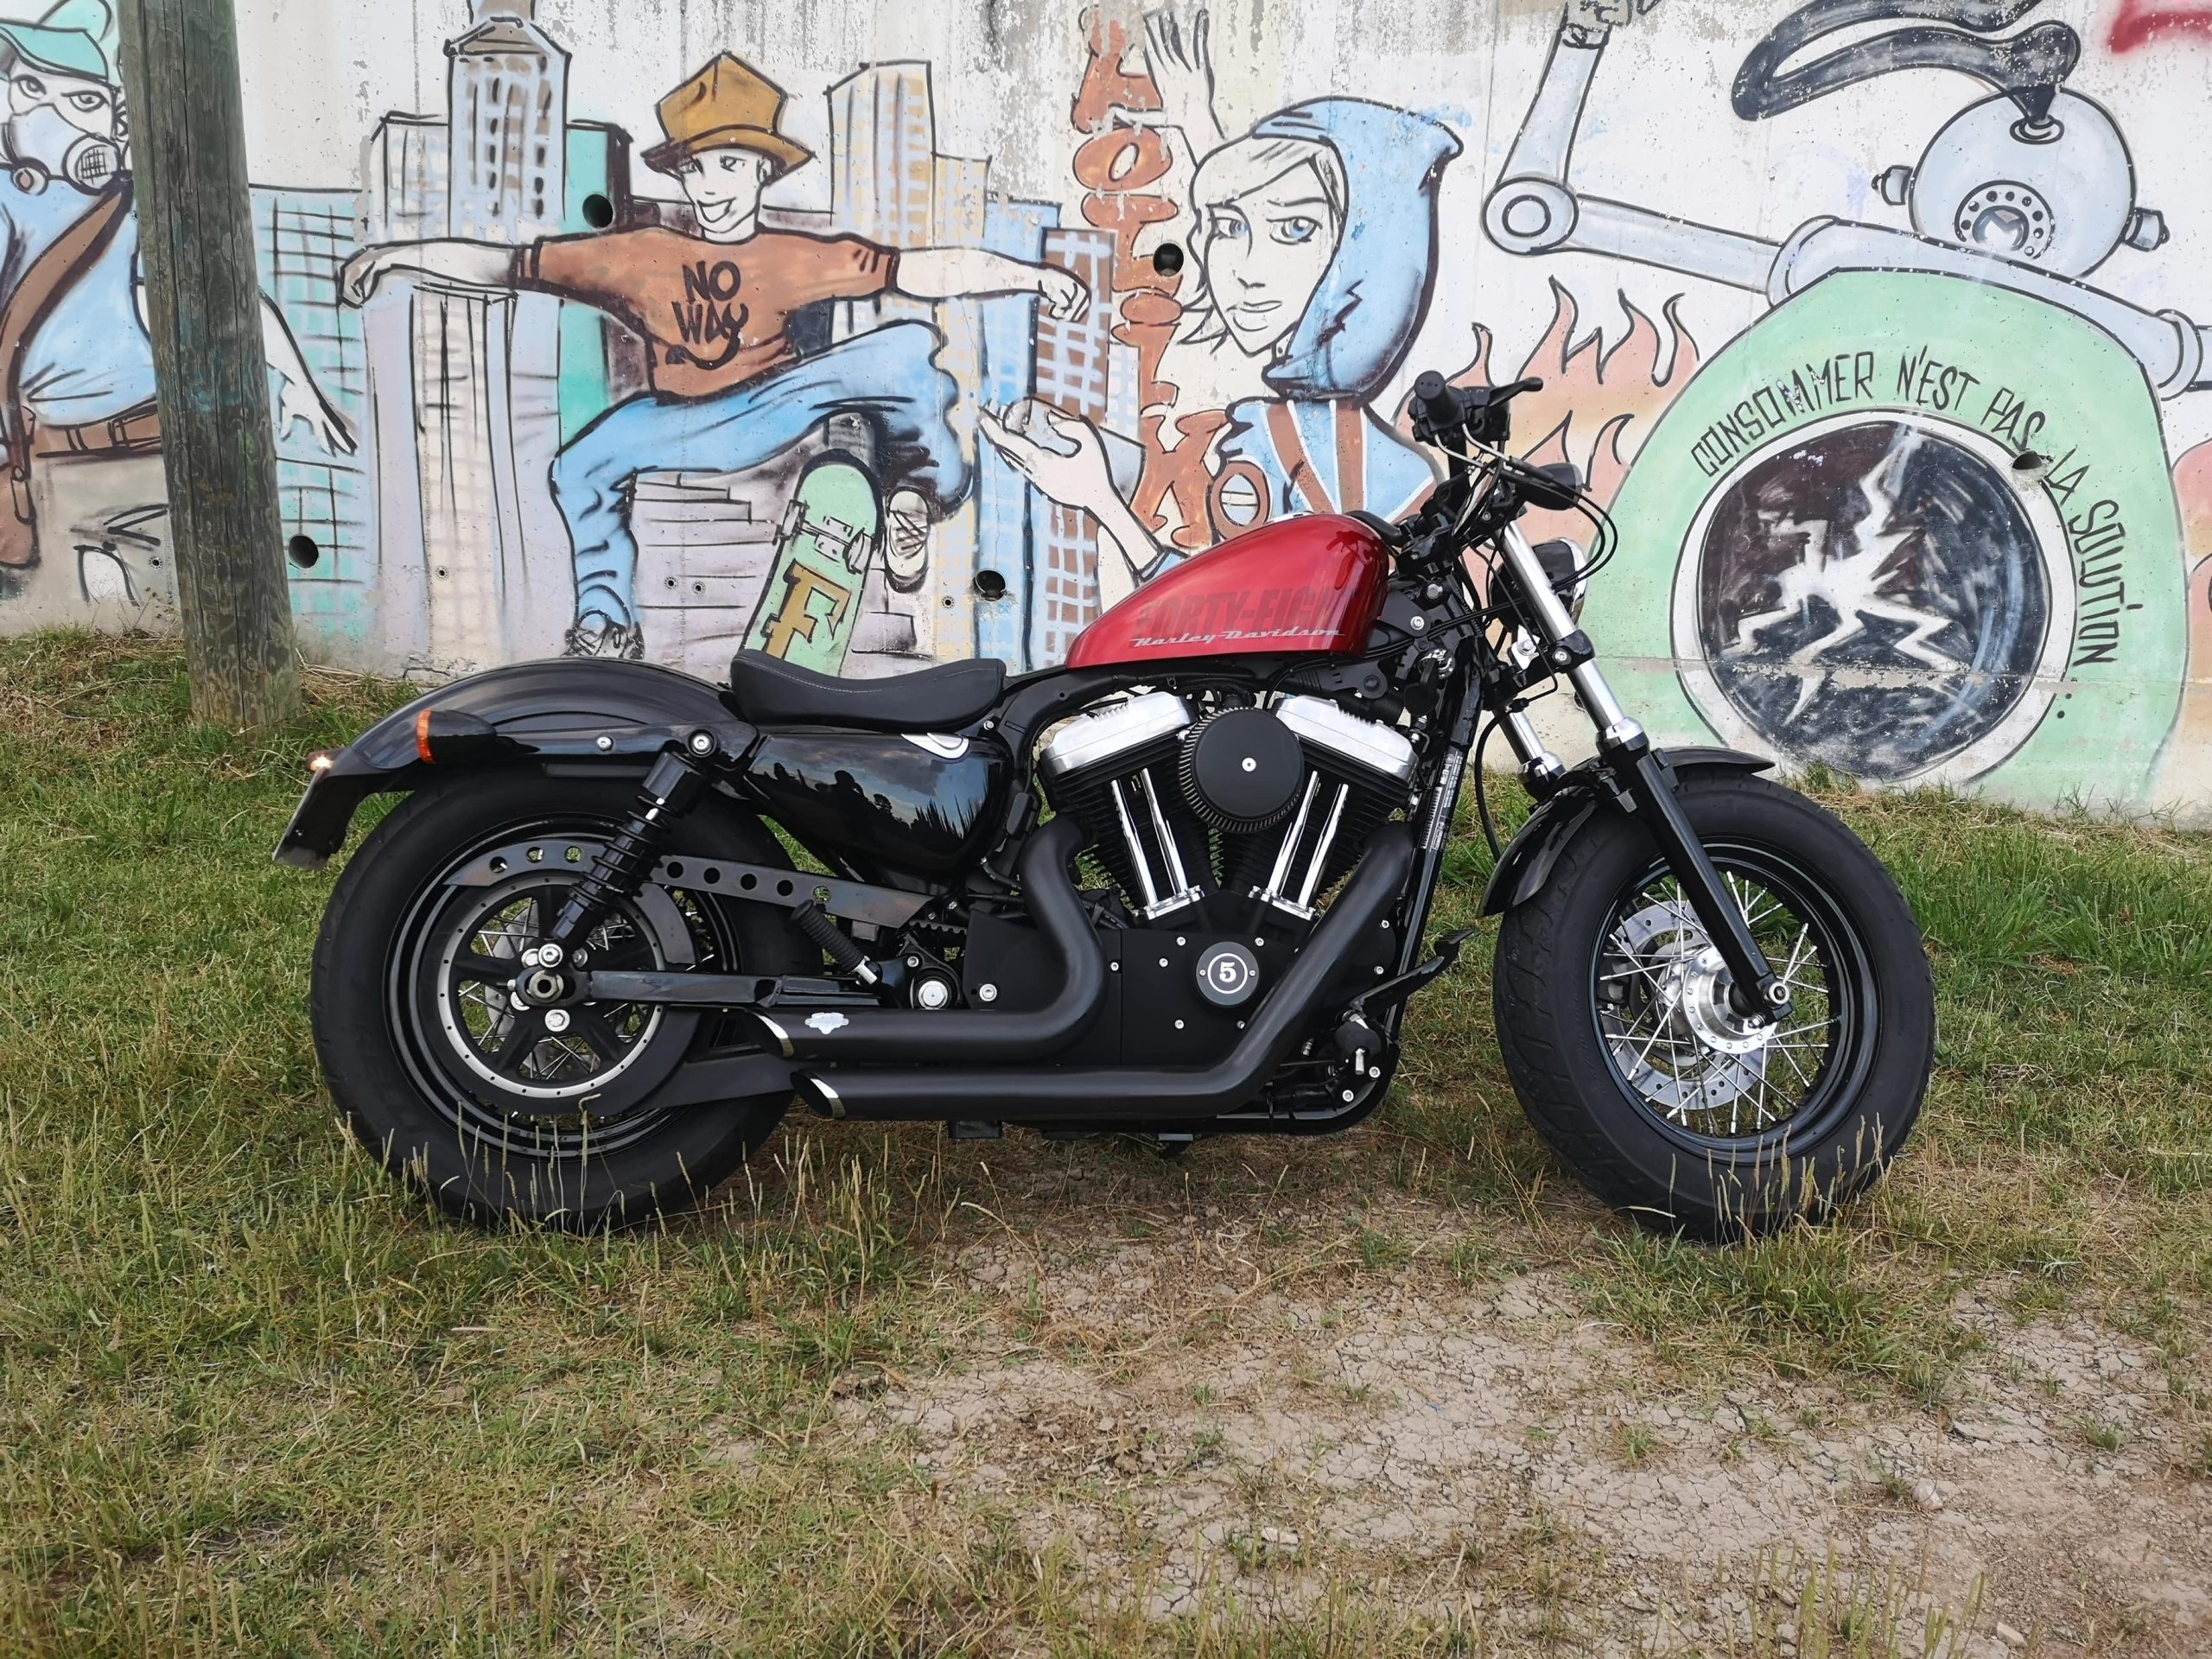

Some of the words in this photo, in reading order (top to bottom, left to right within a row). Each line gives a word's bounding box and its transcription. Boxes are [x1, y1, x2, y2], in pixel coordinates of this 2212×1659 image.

[682, 260, 741, 302] NO
[665, 299, 749, 371] WAY
[1691, 351, 1874, 478] CONSOMMER
[1897, 345, 1980, 410] N'EST
[1980, 387, 2046, 452] PAS
[2044, 445, 2090, 505] LA
[2068, 499, 2144, 667] SOLUTION
[1219, 961, 1237, 983] 5
